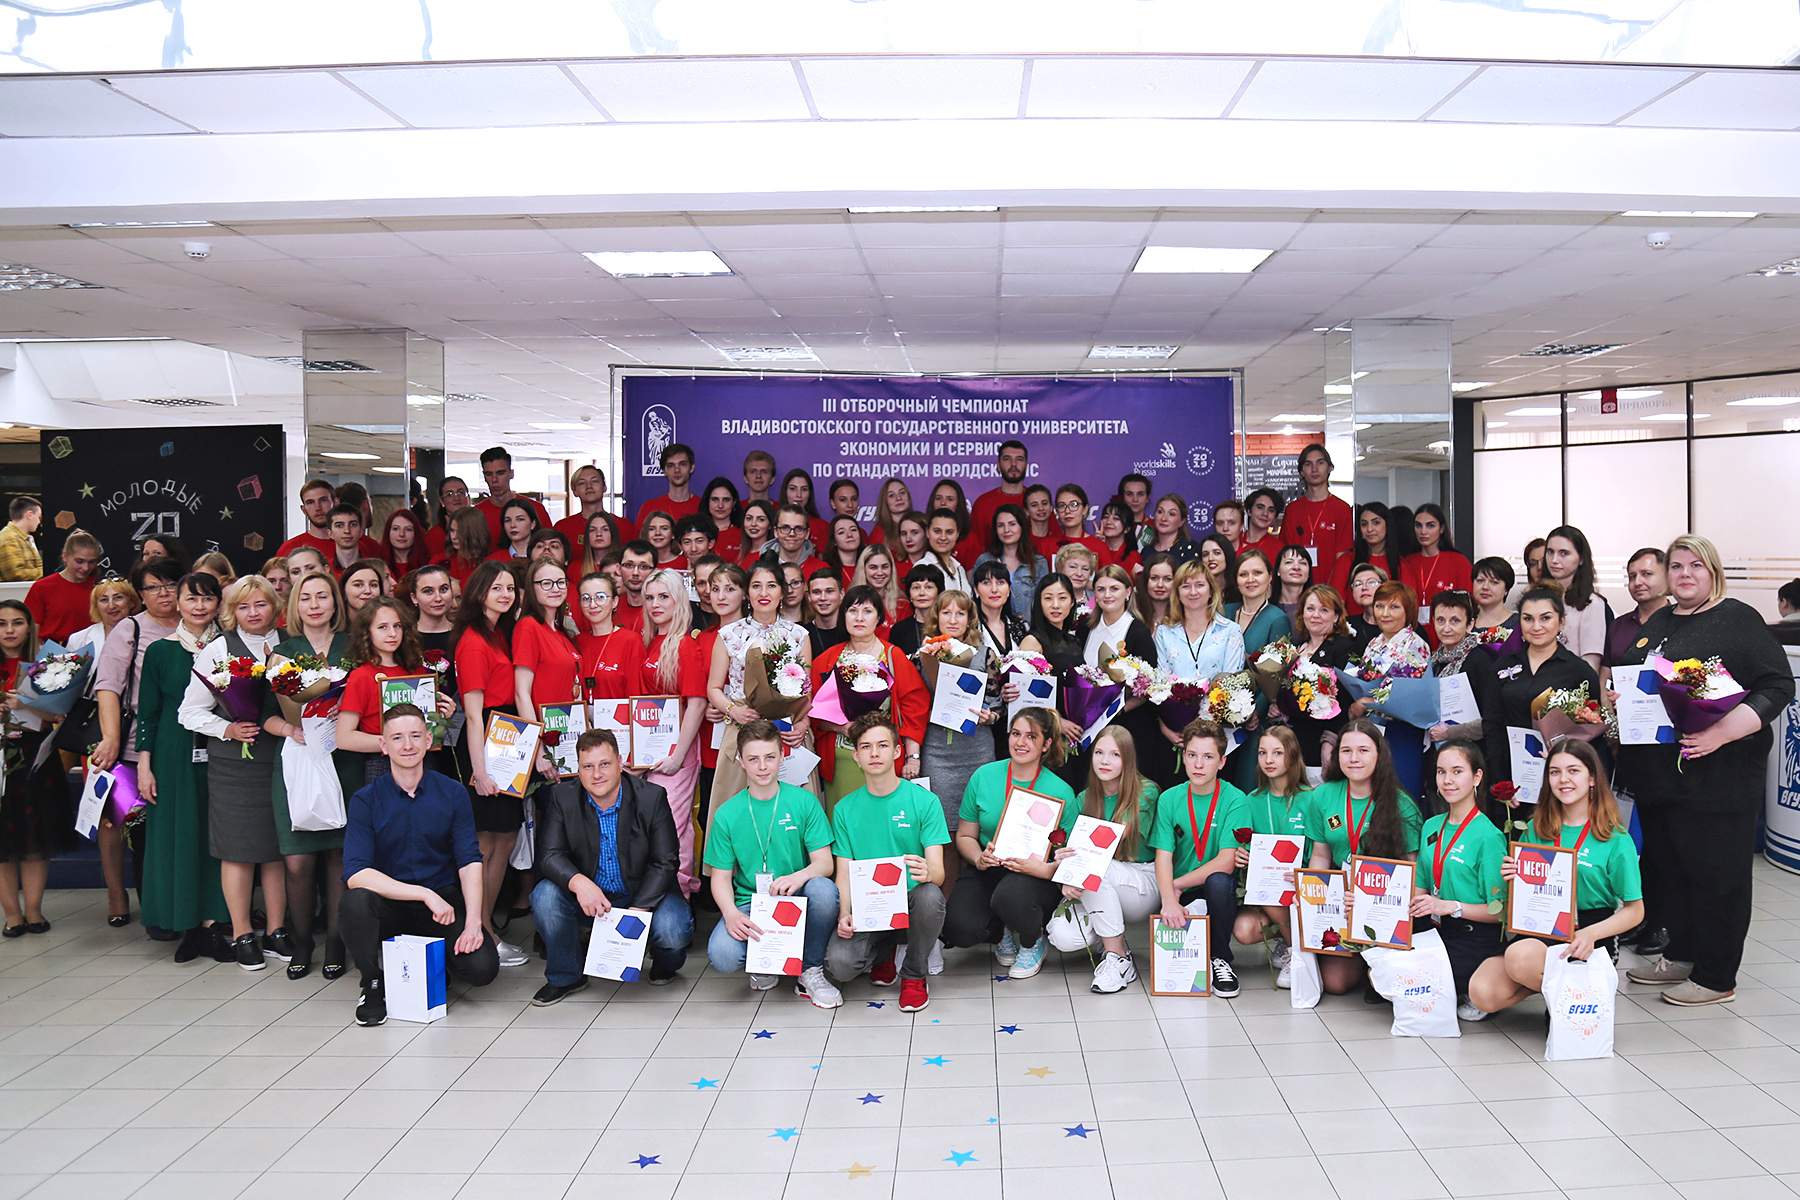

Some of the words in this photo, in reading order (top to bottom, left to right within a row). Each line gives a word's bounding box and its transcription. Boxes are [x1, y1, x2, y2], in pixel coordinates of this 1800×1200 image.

[822, 398, 837, 413] III
[840, 396, 938, 413] ОТБОРОЧНЫЙ
[942, 398, 1029, 413] ЧЕМПИОНАТ
[721, 419, 872, 436] ВЛАДИВОСТОКСКОГО
[875, 420, 1019, 436] ГОСУДАРСТВЕННОГО
[1022, 420, 1129, 435] УНИВЕРСИТЕТА
[839, 441, 930, 456] ЭКОНОМИКИ
[934, 441, 944, 456] И
[813, 463, 835, 478] ПО
[837, 462, 929, 479] СТАНДАРТАМ
[1133, 459, 1177, 469] worldskills
[100, 480, 202, 517] МОЛОДЫЕ
[385, 691, 391, 704] 3
[391, 689, 416, 704] МЕСТО
[544, 717, 550, 729] 3
[550, 715, 570, 729] МЕСТО
[640, 708, 663, 721] МЕСТО
[496, 727, 520, 744] МЕСТО
[1781, 789, 1800, 809] ВГУ
[1523, 860, 1551, 877] МЕСТО
[1364, 872, 1391, 888] МЕСТО
[1301, 884, 1306, 897] 2
[1306, 884, 1328, 898] МЕСТО
[1373, 894, 1402, 906] ДИПЛОМ
[1156, 930, 1162, 944] 3
[1162, 930, 1186, 944] МЕСТО
[1568, 1004, 1599, 1014] ВГУЭС
